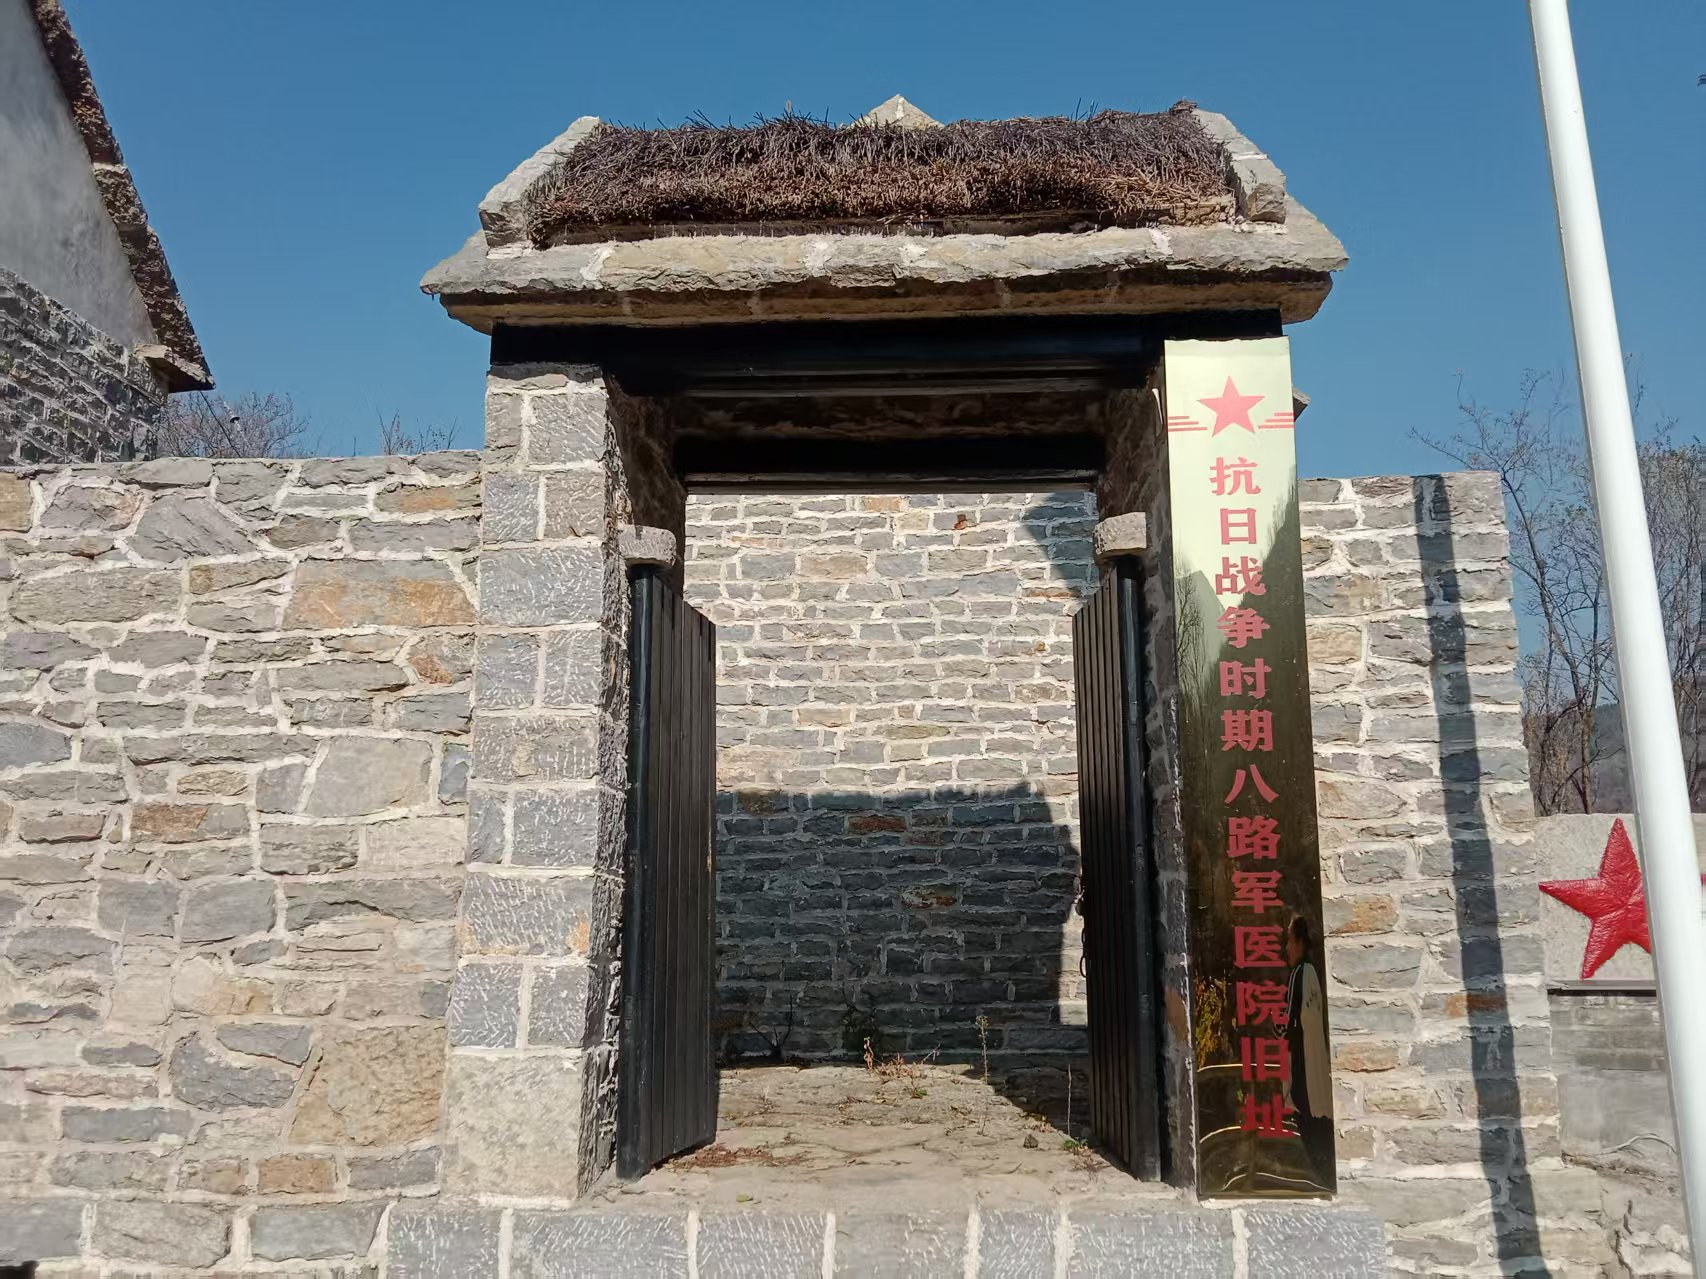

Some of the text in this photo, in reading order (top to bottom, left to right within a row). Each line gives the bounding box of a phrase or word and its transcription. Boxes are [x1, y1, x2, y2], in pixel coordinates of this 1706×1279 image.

[1209, 456, 1296, 1138] 抗日战争时期八路军医院旧址
